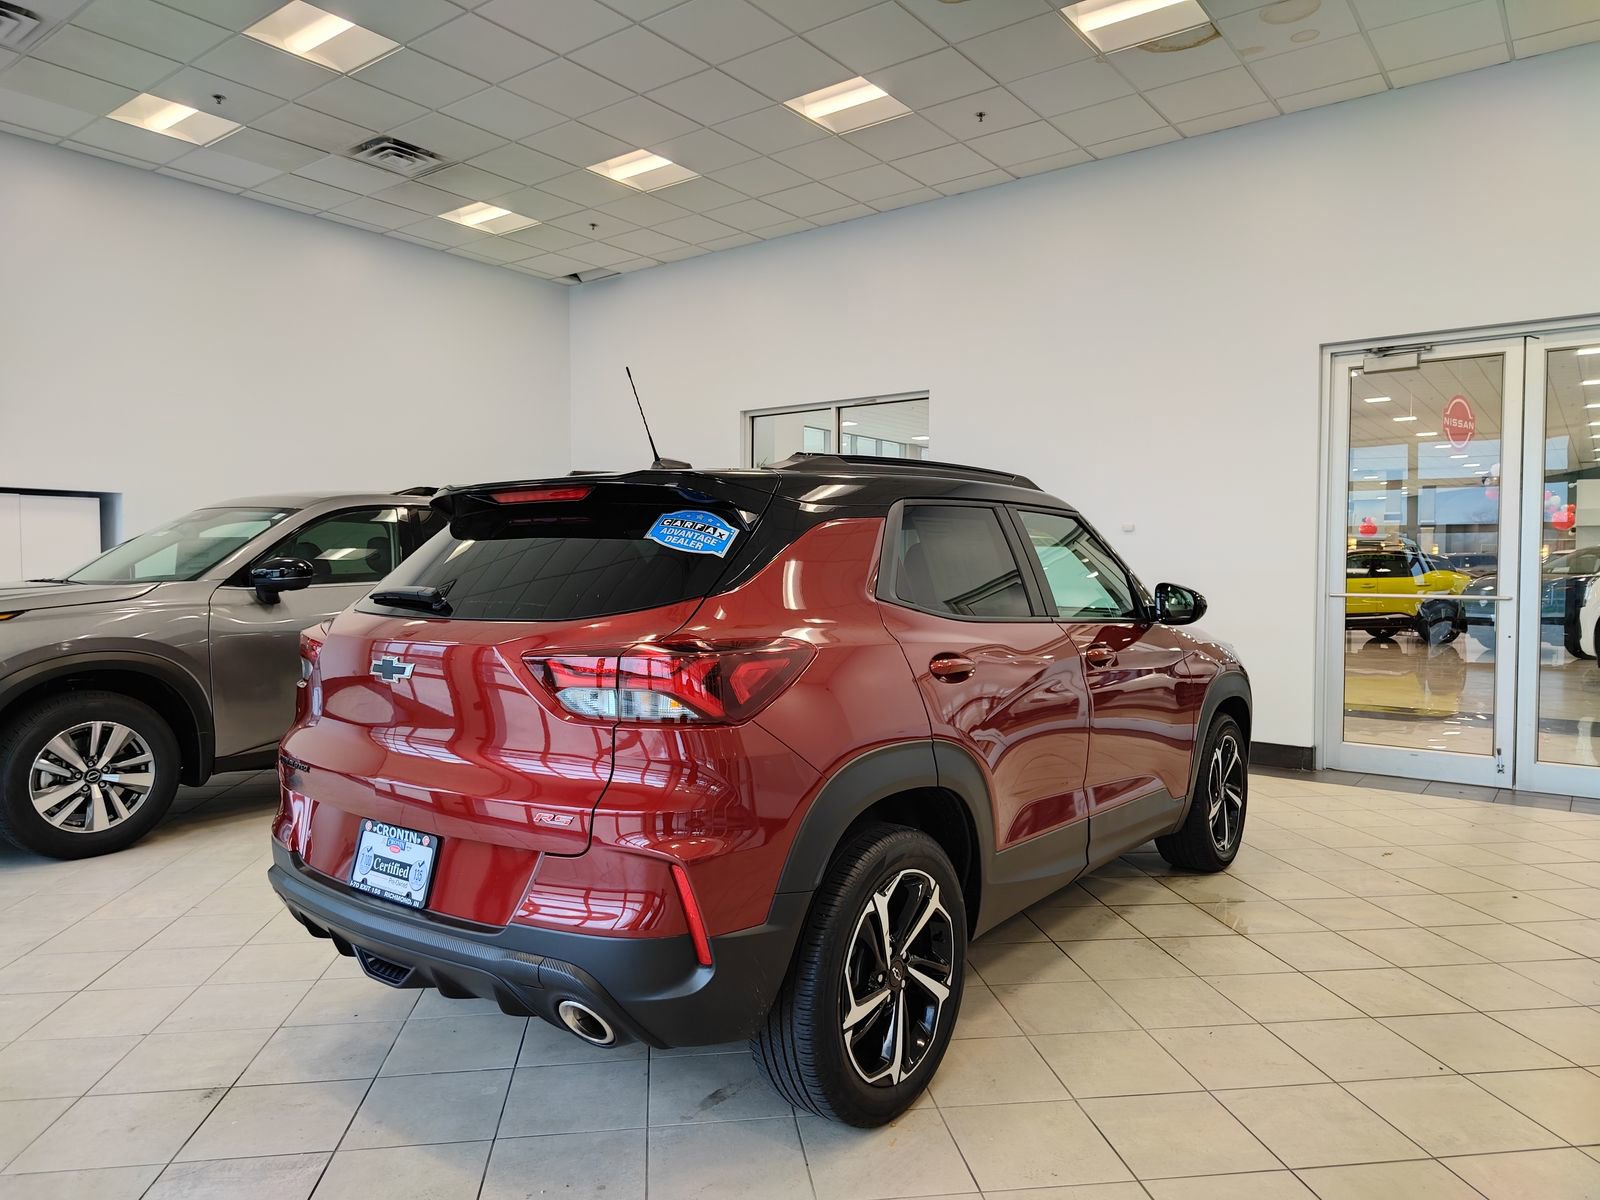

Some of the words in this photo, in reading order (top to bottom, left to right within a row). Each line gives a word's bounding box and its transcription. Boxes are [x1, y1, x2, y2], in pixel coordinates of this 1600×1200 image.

[1443, 416, 1475, 430] NISSAN
[659, 527, 718, 546] ADVANTAGE
[662, 519, 726, 539] CARFAX
[664, 535, 704, 550] DEALER
[533, 812, 575, 826] RS
[376, 823, 418, 844] CRONIN
[373, 857, 410, 878] Certified
